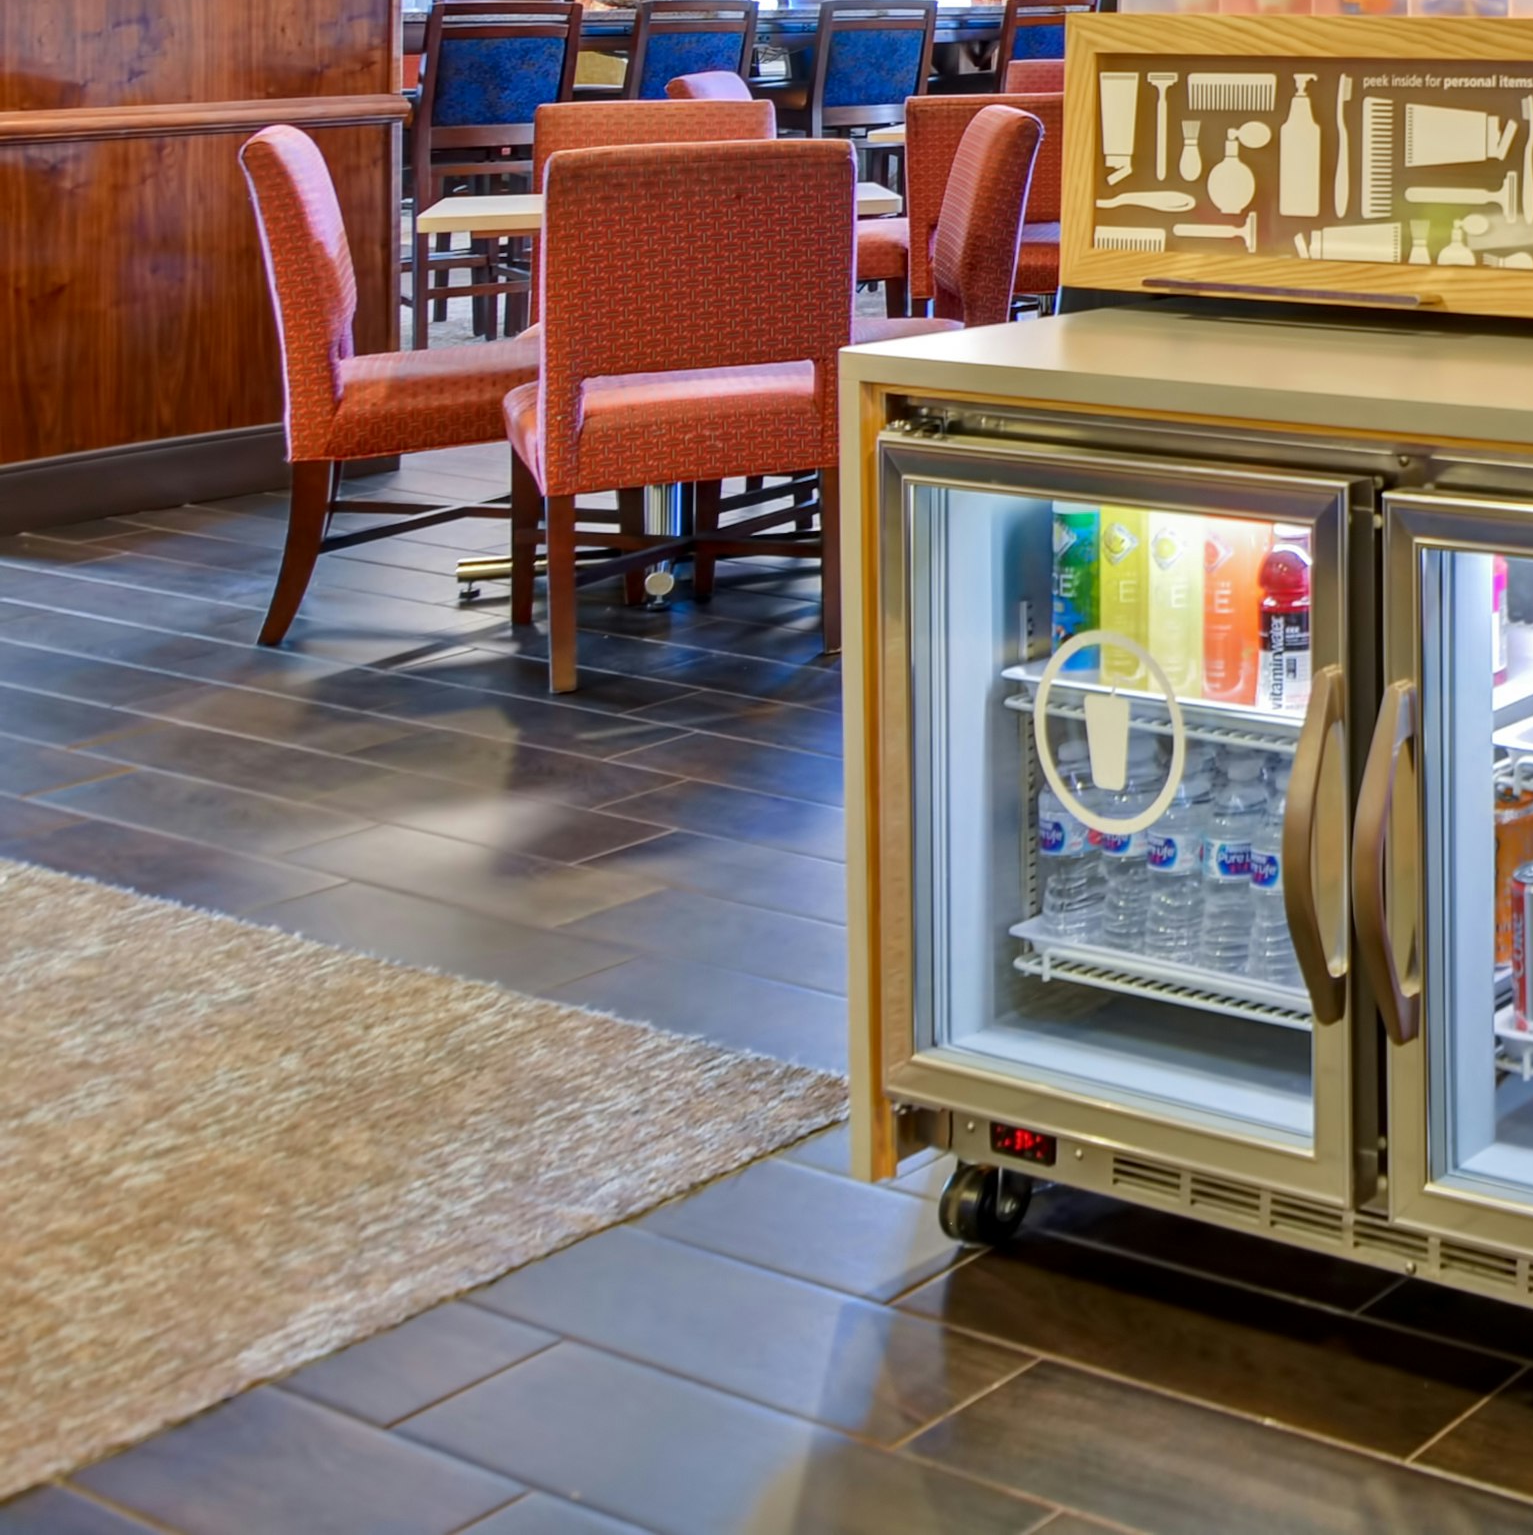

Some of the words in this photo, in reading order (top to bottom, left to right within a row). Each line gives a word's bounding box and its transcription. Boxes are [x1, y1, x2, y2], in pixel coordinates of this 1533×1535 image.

[1363, 74, 1389, 89] peek
[1392, 73, 1423, 87] inside
[1425, 74, 1442, 87] for
[1443, 74, 1497, 90] personal
[1271, 615, 1285, 711] vitaminwater
